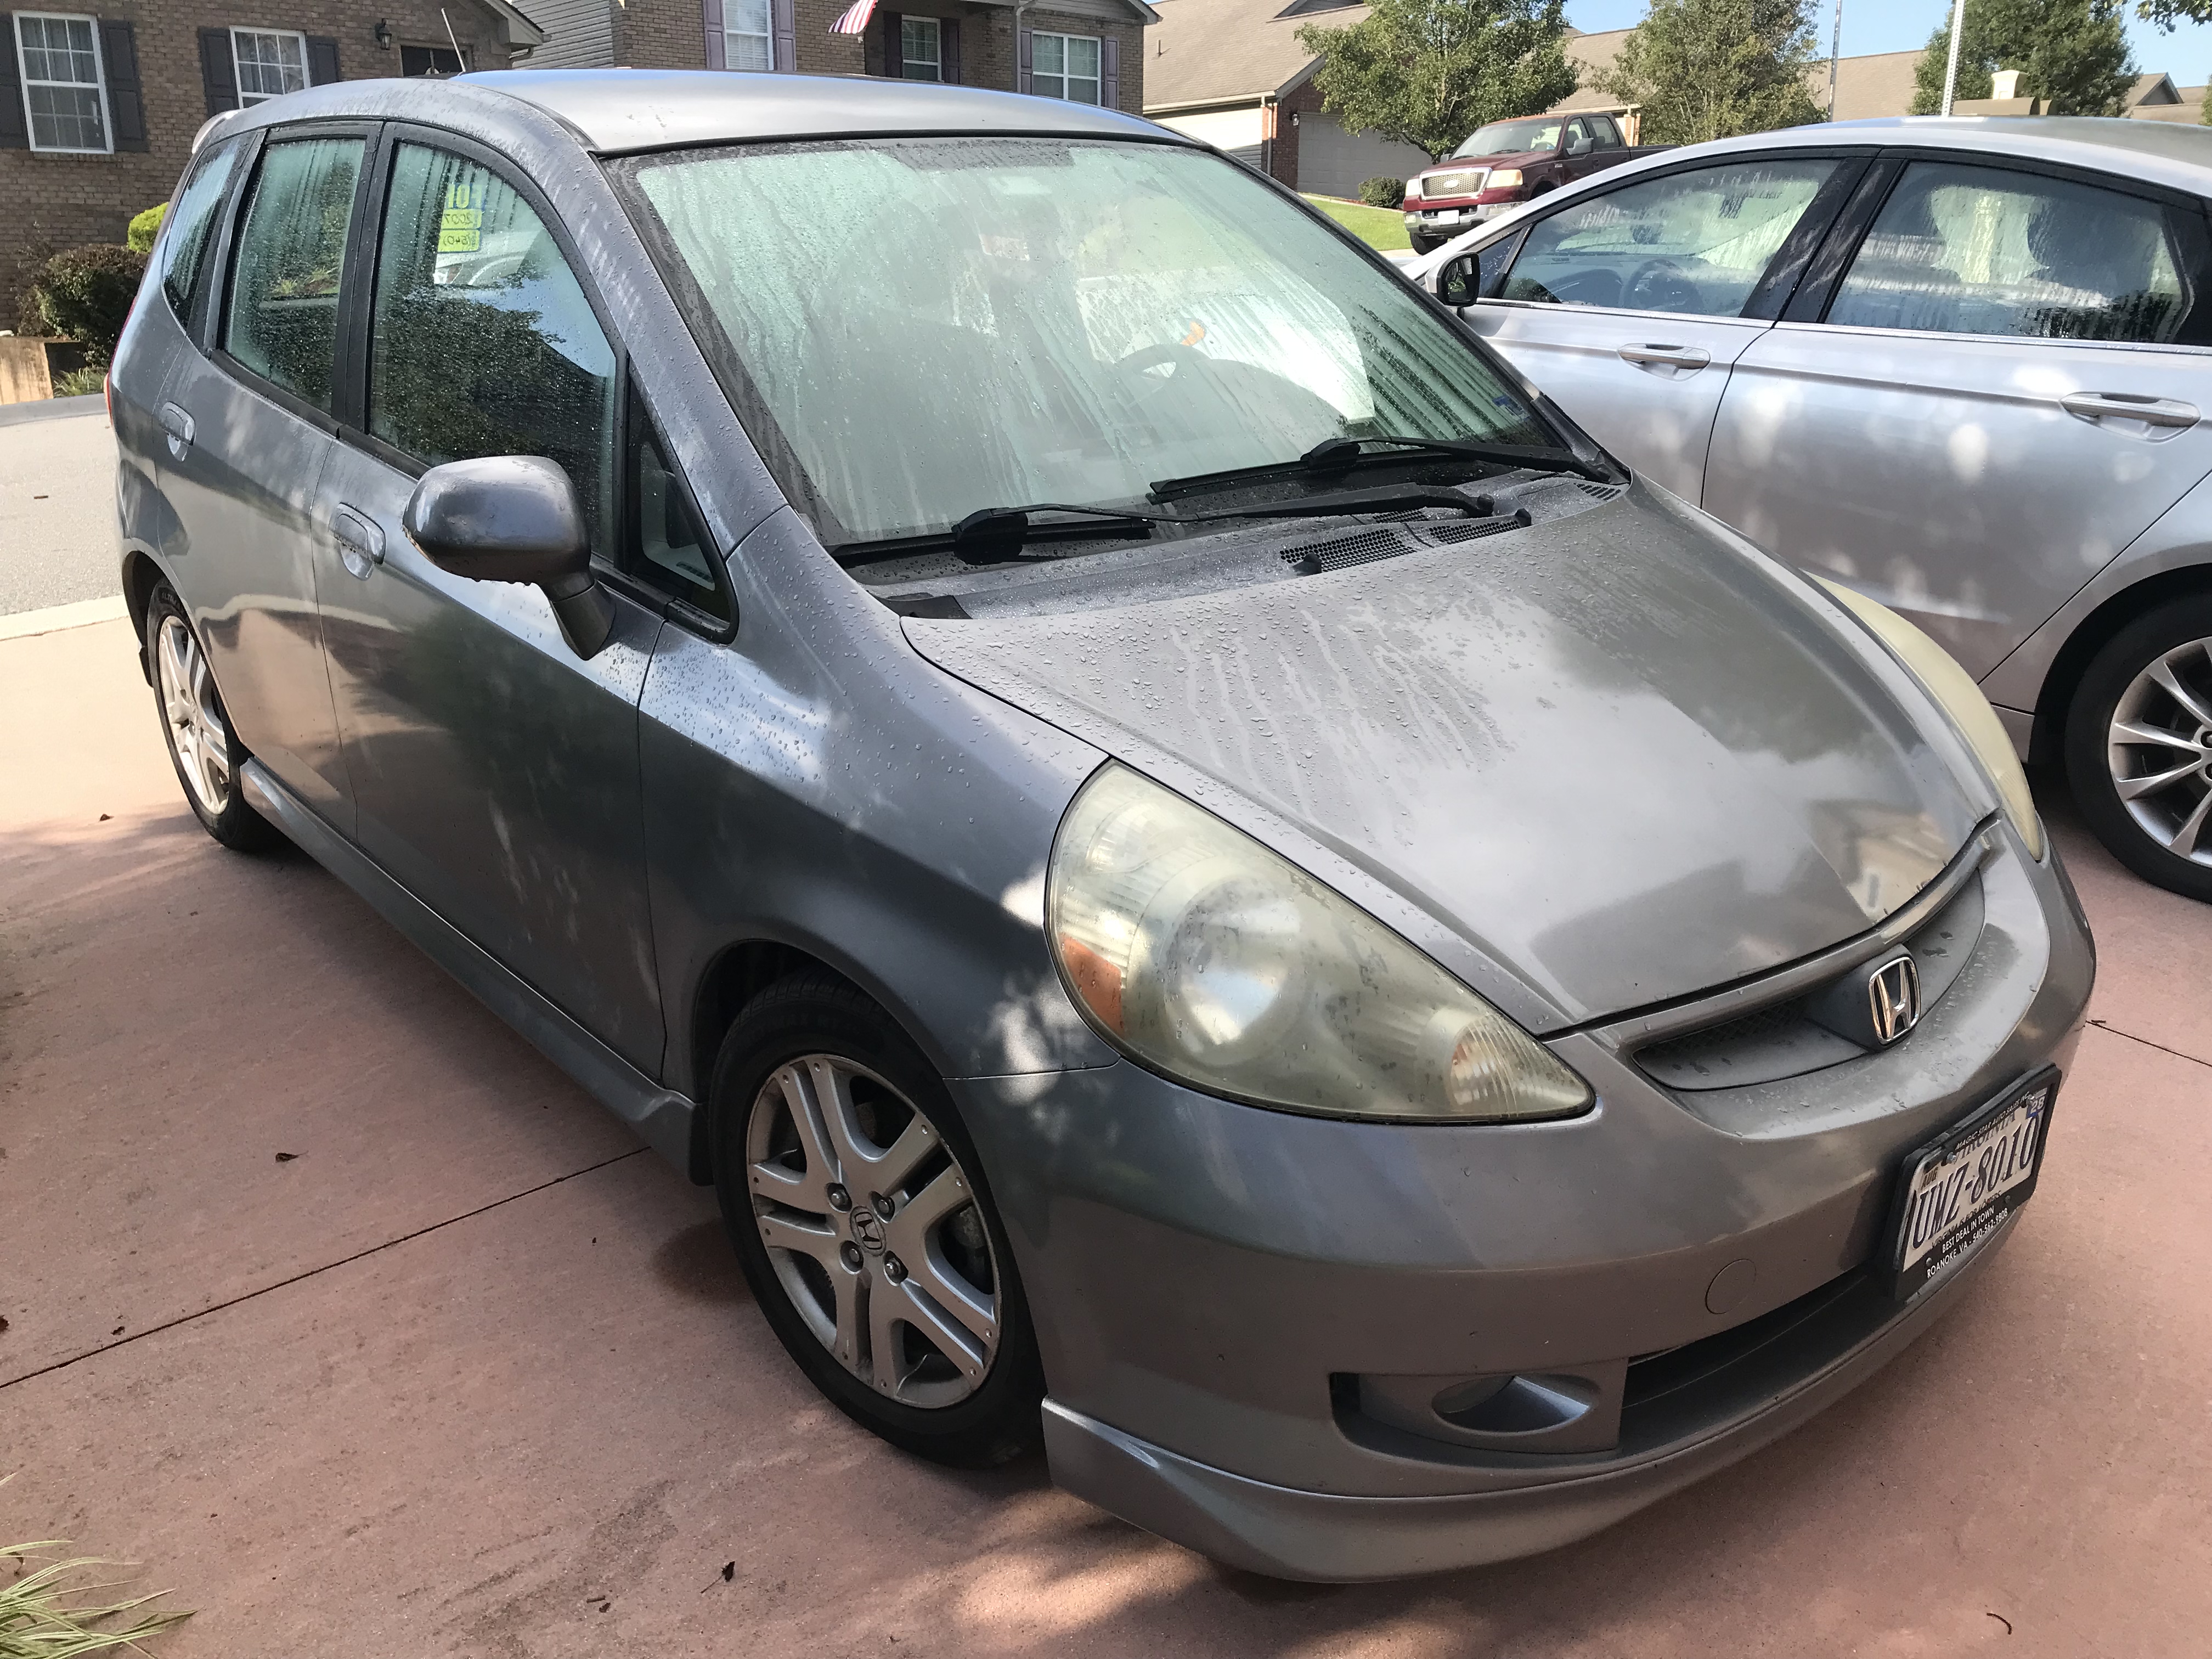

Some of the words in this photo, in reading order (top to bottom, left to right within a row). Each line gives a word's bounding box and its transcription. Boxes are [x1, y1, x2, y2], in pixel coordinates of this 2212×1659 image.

[1921, 1166, 1939, 1190] AUG
[1942, 1237, 1955, 1254] BEST
[1956, 1224, 1970, 1243] DEAL
[1971, 1218, 1977, 1231] IN
[1978, 1205, 1995, 1225] TOWN
[1959, 1240, 1968, 1254] VA
